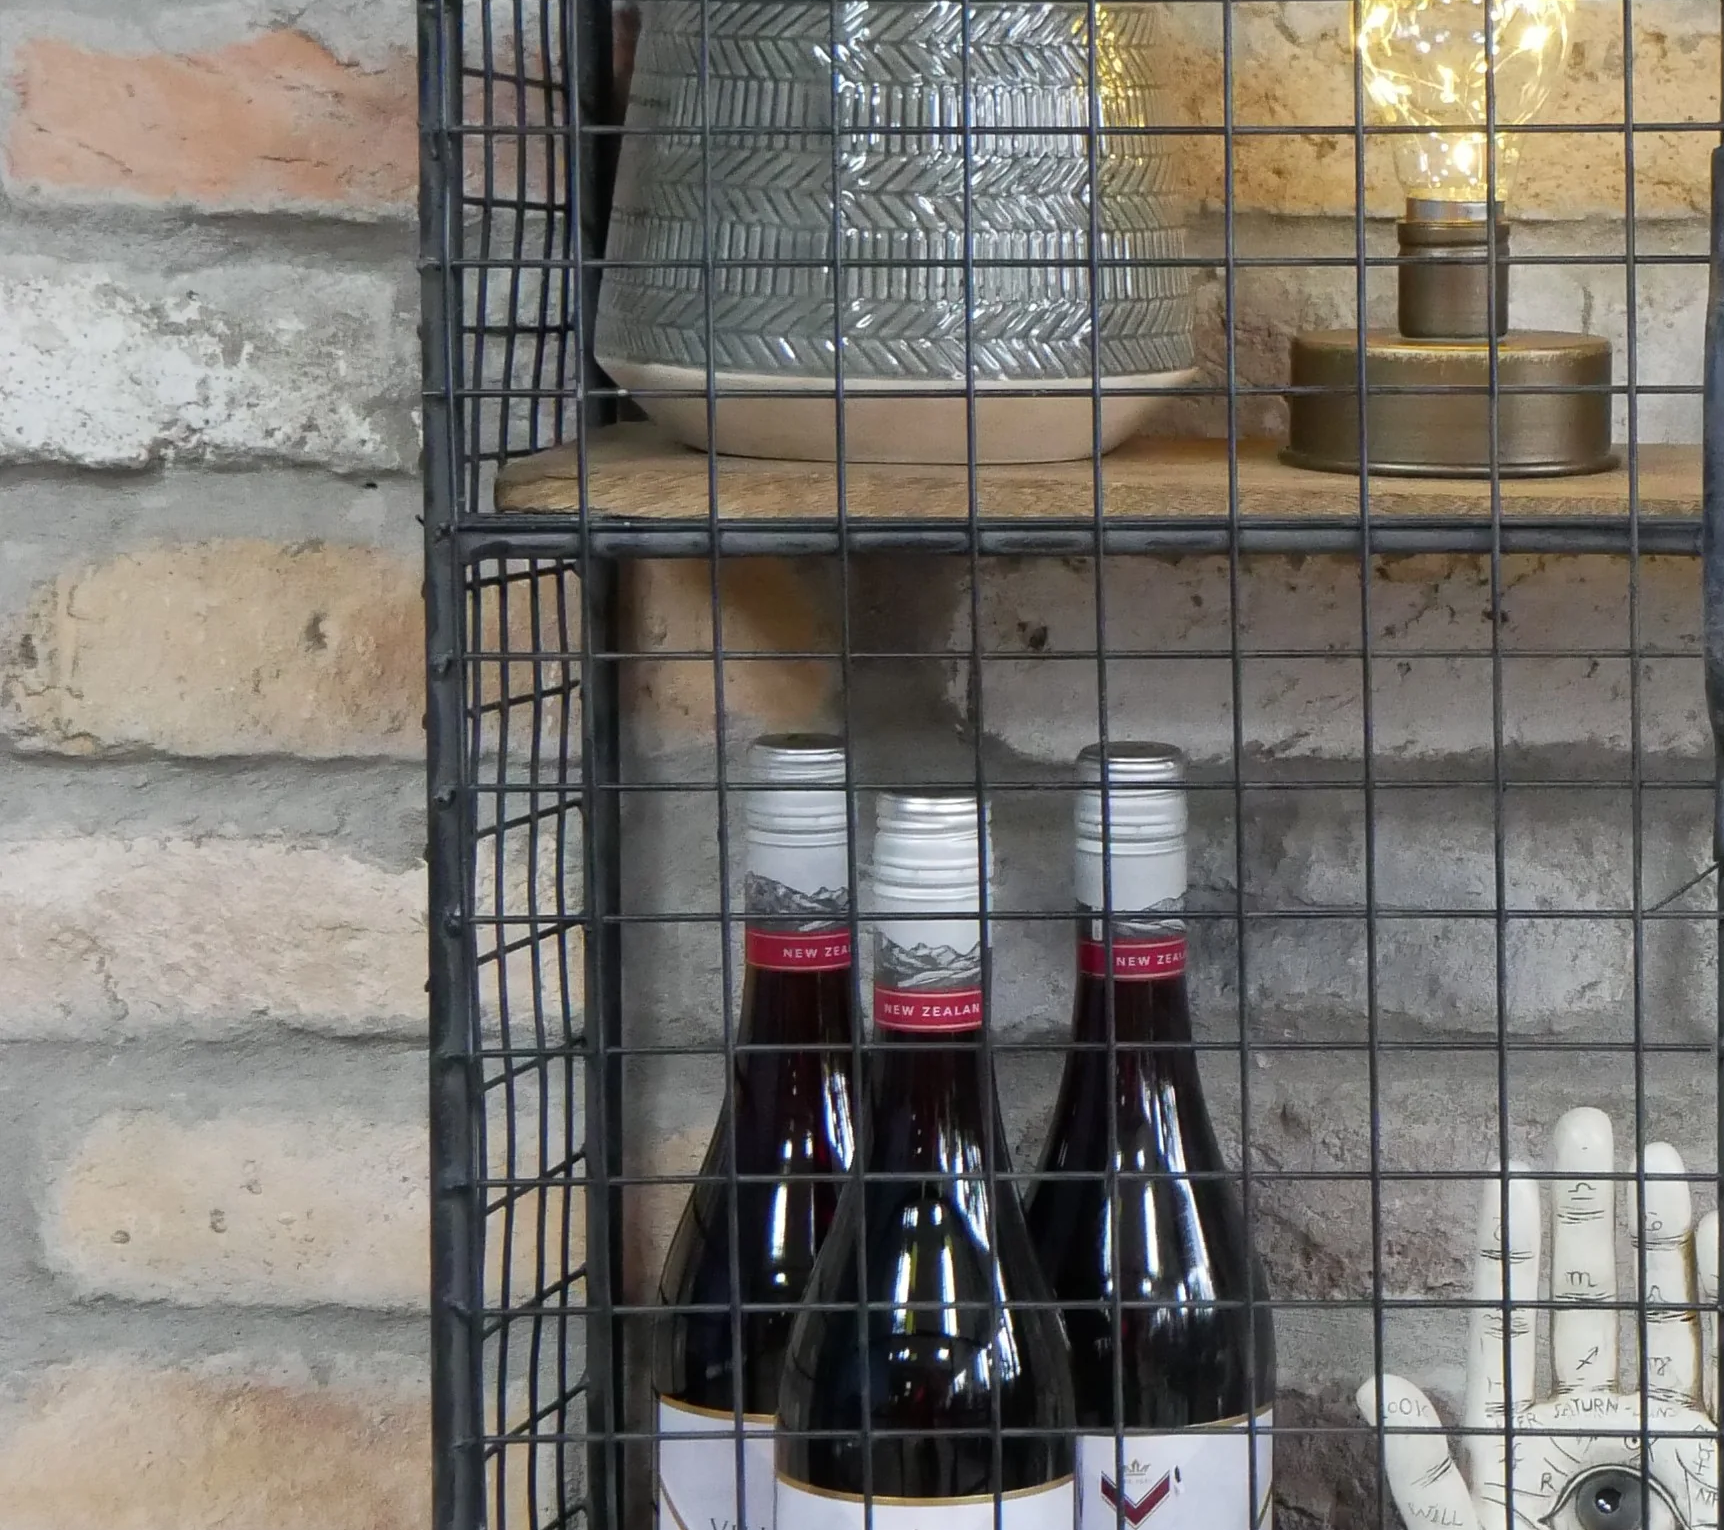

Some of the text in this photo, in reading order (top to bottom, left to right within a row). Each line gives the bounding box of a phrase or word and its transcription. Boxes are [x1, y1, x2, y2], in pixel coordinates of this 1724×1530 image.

[783, 948, 817, 958] NEW
[1116, 956, 1150, 967] NEW
[884, 1003, 980, 1017] NEW ZEALAN
[1407, 1501, 1463, 1526] WILL
